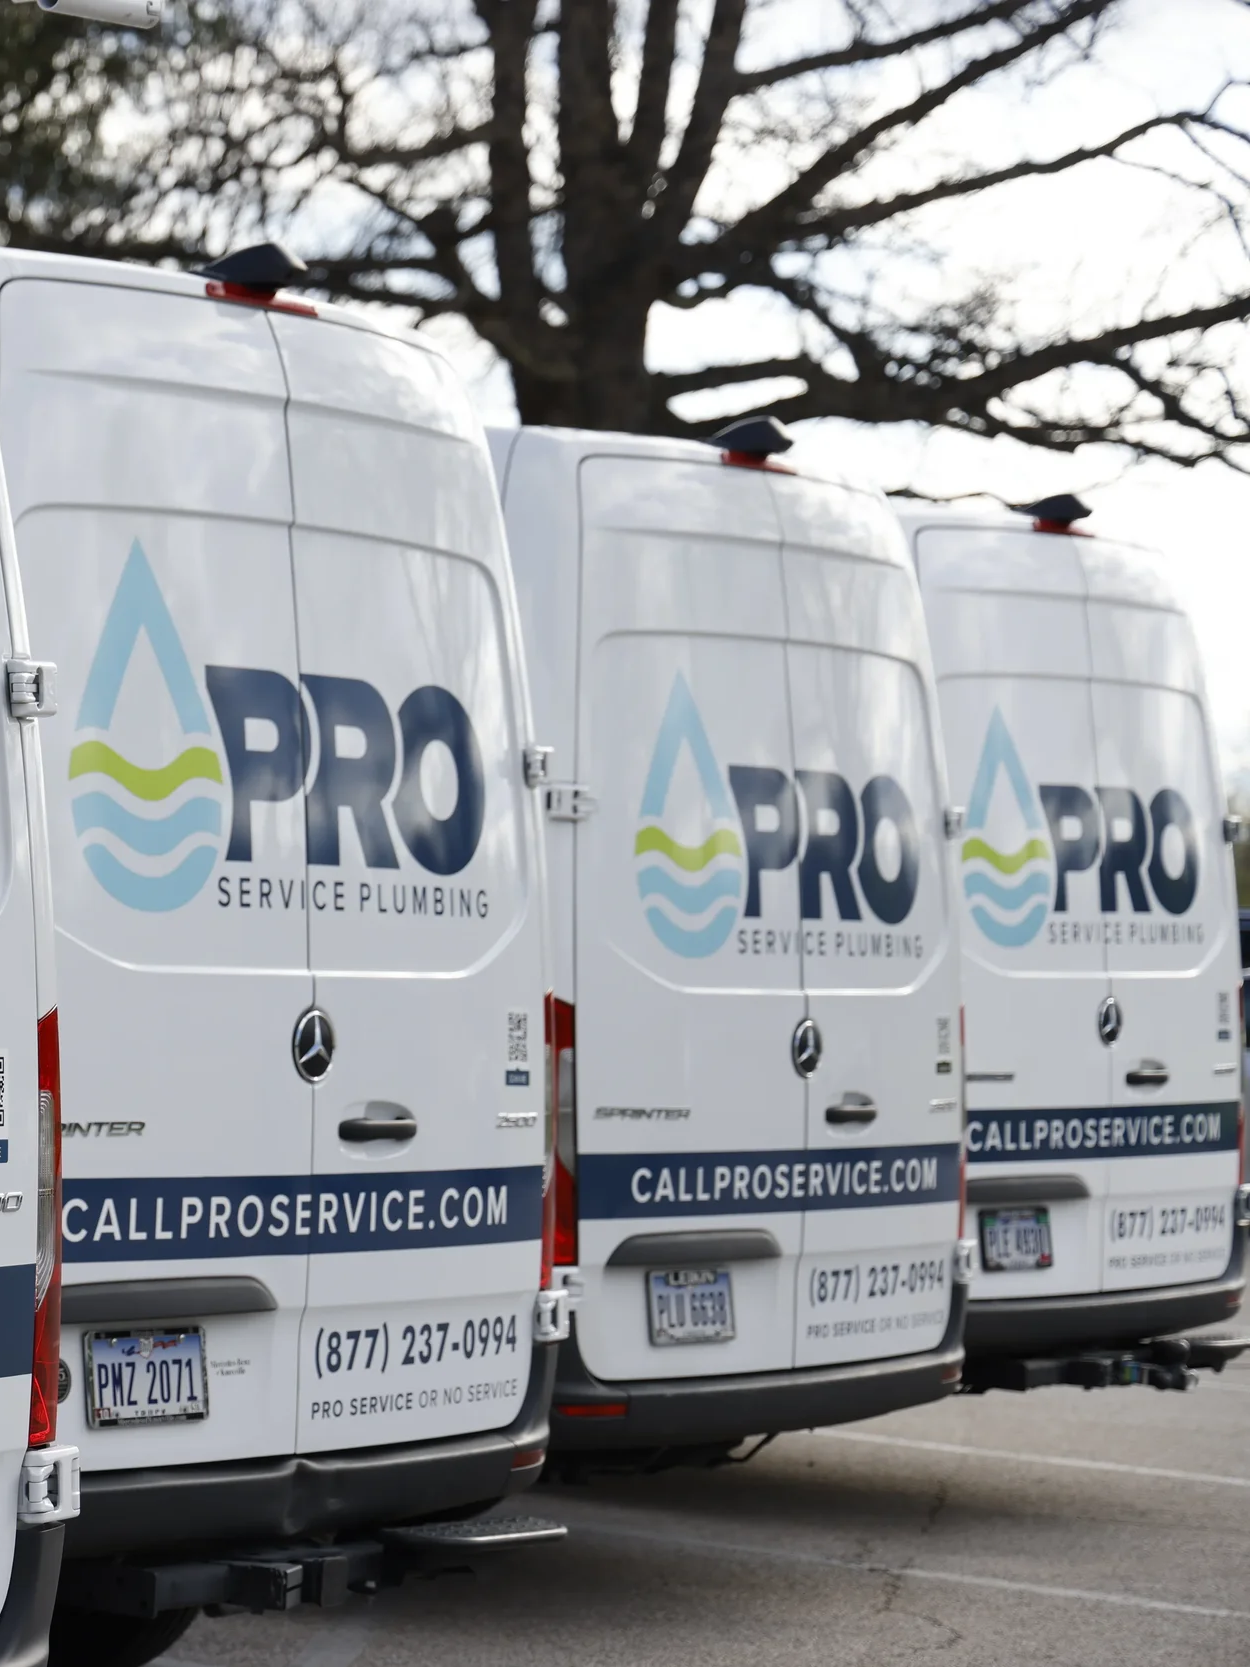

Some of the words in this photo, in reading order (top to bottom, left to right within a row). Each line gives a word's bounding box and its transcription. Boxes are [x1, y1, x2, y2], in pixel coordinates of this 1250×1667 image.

[205, 664, 485, 876] PRO
[728, 765, 920, 925] PRO
[1039, 784, 1198, 915] PRO
[217, 876, 345, 911] SERVICE
[360, 882, 489, 918] PLUMBING
[737, 929, 827, 957] SERVICE
[834, 931, 924, 959] PLUMBING
[1048, 921, 1123, 945] SERVICE
[1130, 922, 1204, 945] PLUMBING
[965, 1113, 1222, 1152] CALLPROSERVICE.COM
[631, 1157, 937, 1204] CALLPROSERVICE.COM
[62, 1186, 508, 1243] CALLPROSERVICE.COM
[1110, 1205, 1153, 1243] (877)
[809, 1264, 860, 1309] (877)
[868, 1259, 944, 1298] 237-0994
[315, 1322, 389, 1379] (877)
[401, 1314, 517, 1366] 237-0994
[832, 1317, 876, 1338] SERVICE
[97, 1362, 137, 1407] PMZ
[146, 1358, 198, 1405] 2071
[311, 1400, 343, 1420] PRO
[350, 1392, 413, 1416] SERVICE
[418, 1389, 438, 1408] OR
[443, 1386, 462, 1405] NO
[467, 1379, 518, 1403] SERVICE
